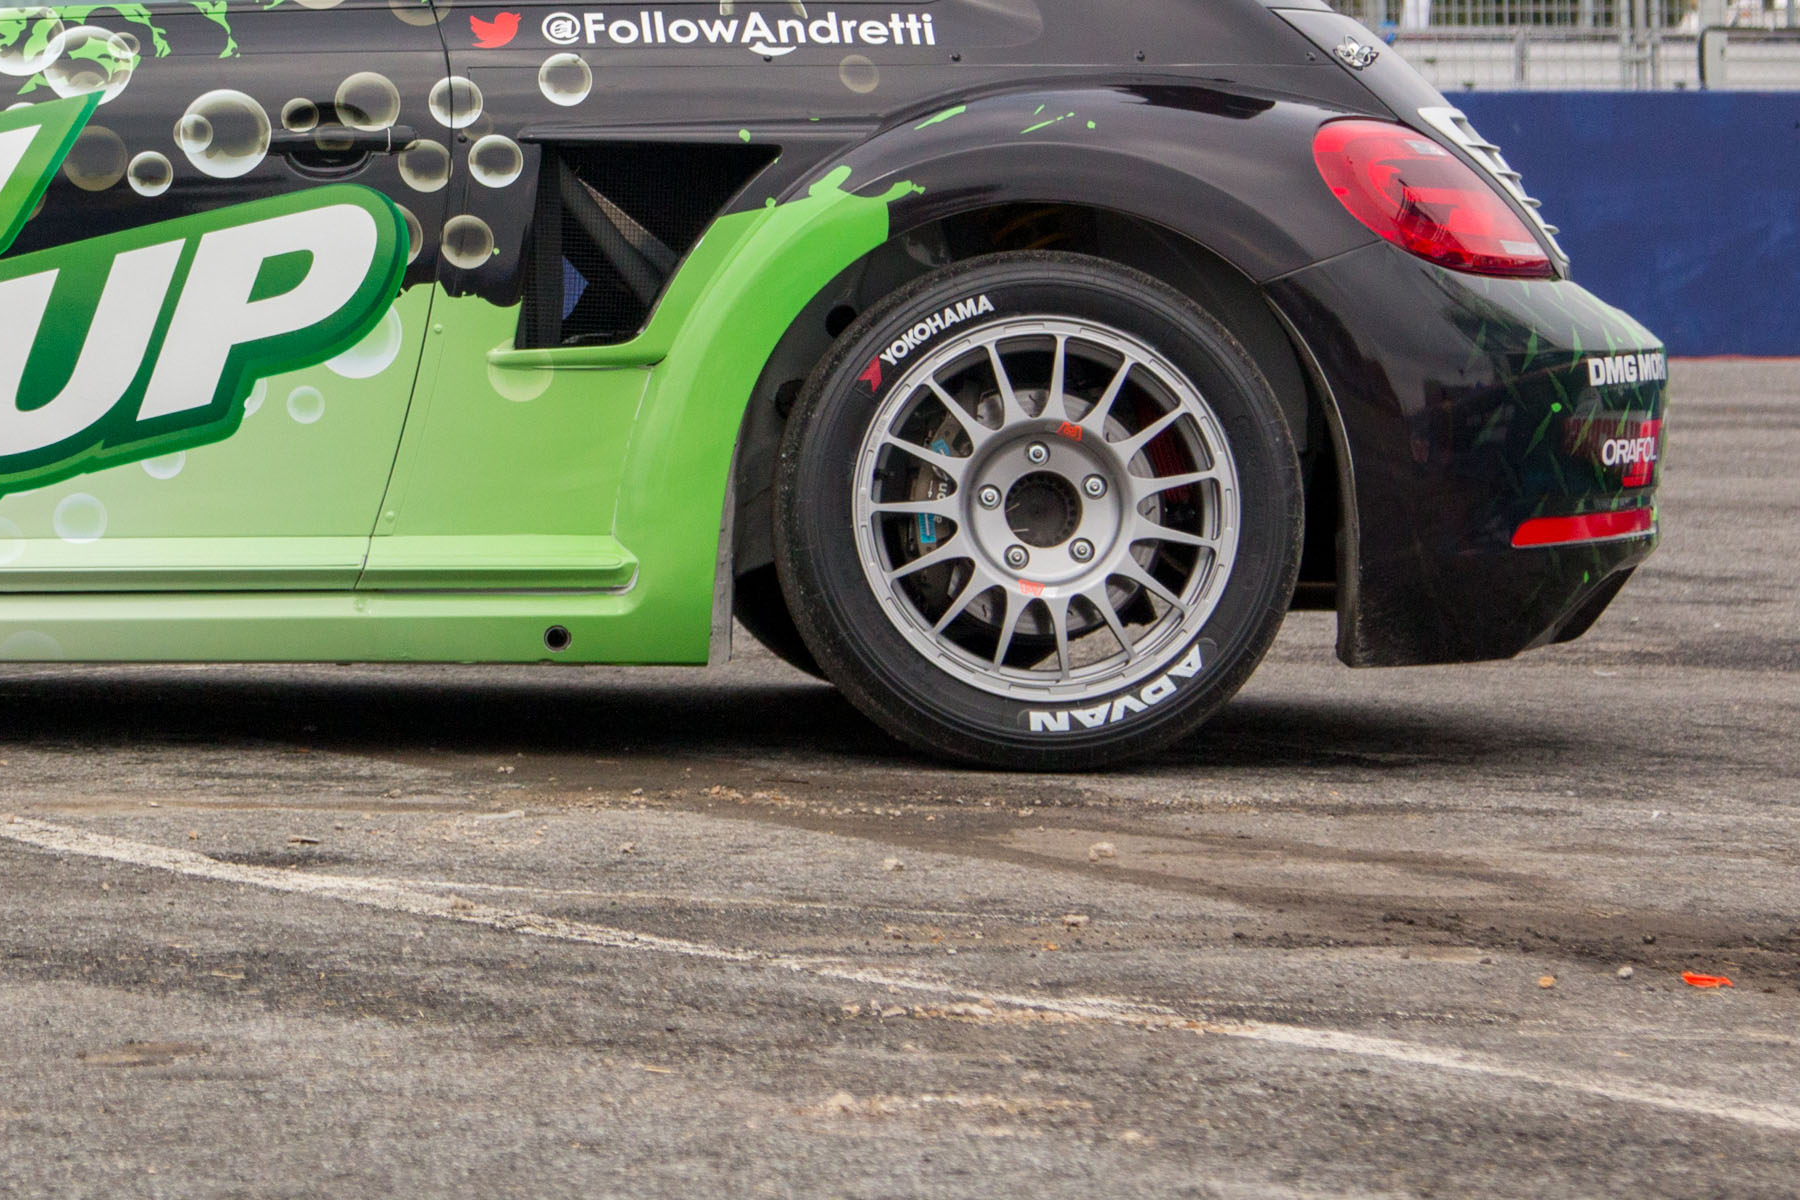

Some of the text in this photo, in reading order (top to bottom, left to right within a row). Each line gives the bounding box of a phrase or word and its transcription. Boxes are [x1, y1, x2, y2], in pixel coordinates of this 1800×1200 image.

[541, 10, 936, 46] @FollowAndretti
[879, 294, 995, 367] YOKOHAMA
[1587, 354, 1637, 386] DMG
[1602, 437, 1656, 466] ORAFOL
[1028, 643, 1203, 733] ADVAN
